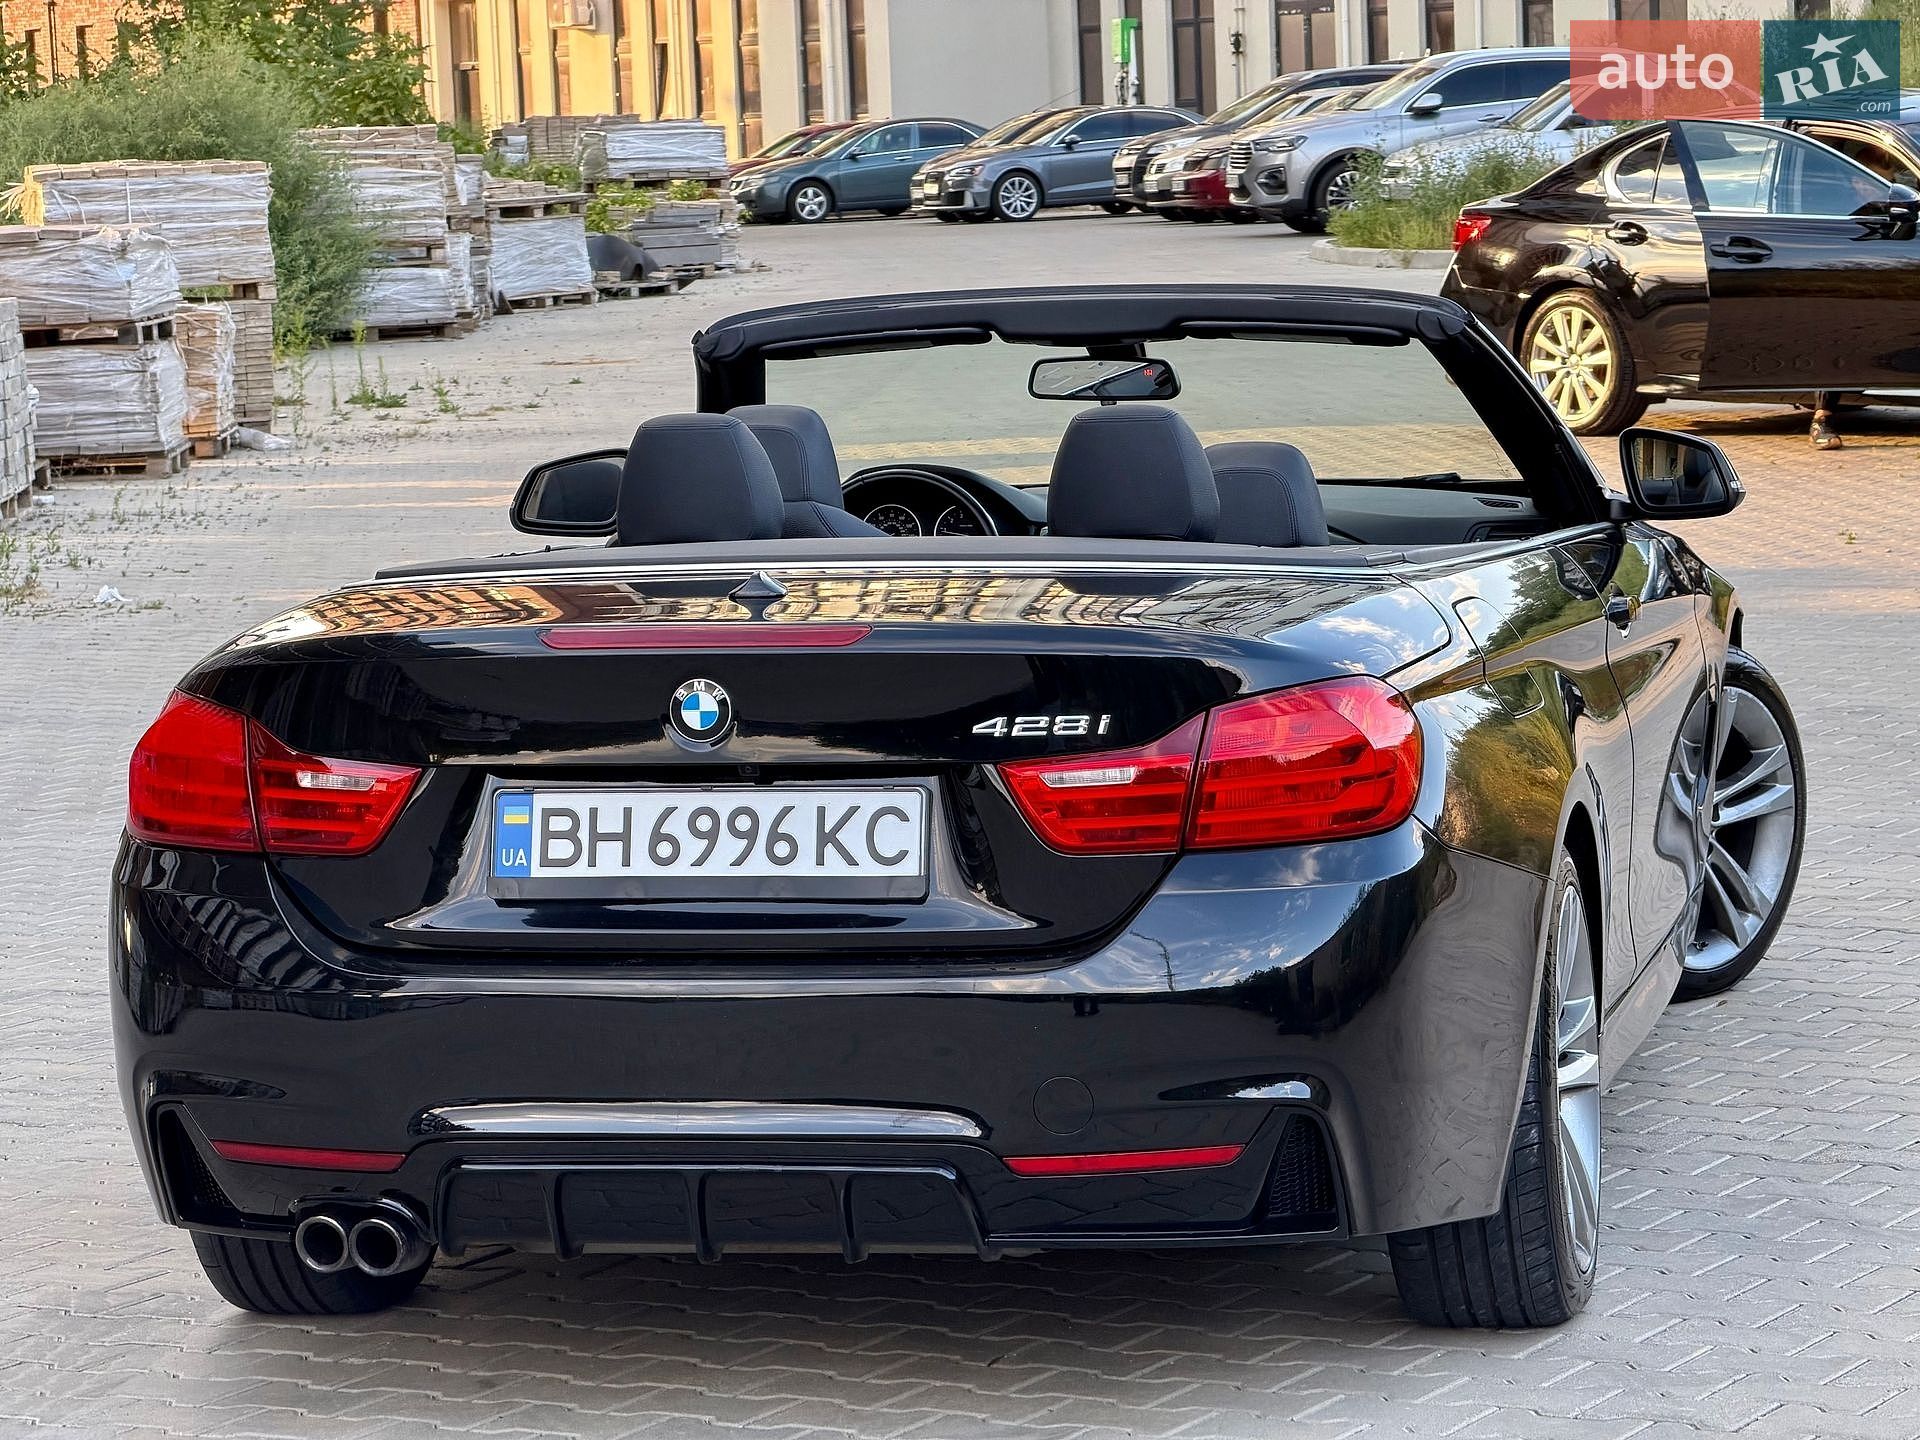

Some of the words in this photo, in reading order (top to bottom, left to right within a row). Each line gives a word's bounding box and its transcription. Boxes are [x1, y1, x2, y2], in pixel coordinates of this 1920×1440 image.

[675, 681, 726, 702] BMW
[972, 714, 1112, 737] 428i
[538, 806, 632, 868] BH
[648, 805, 799, 868] 6996
[815, 805, 910, 867] KC
[501, 848, 529, 868] UA
